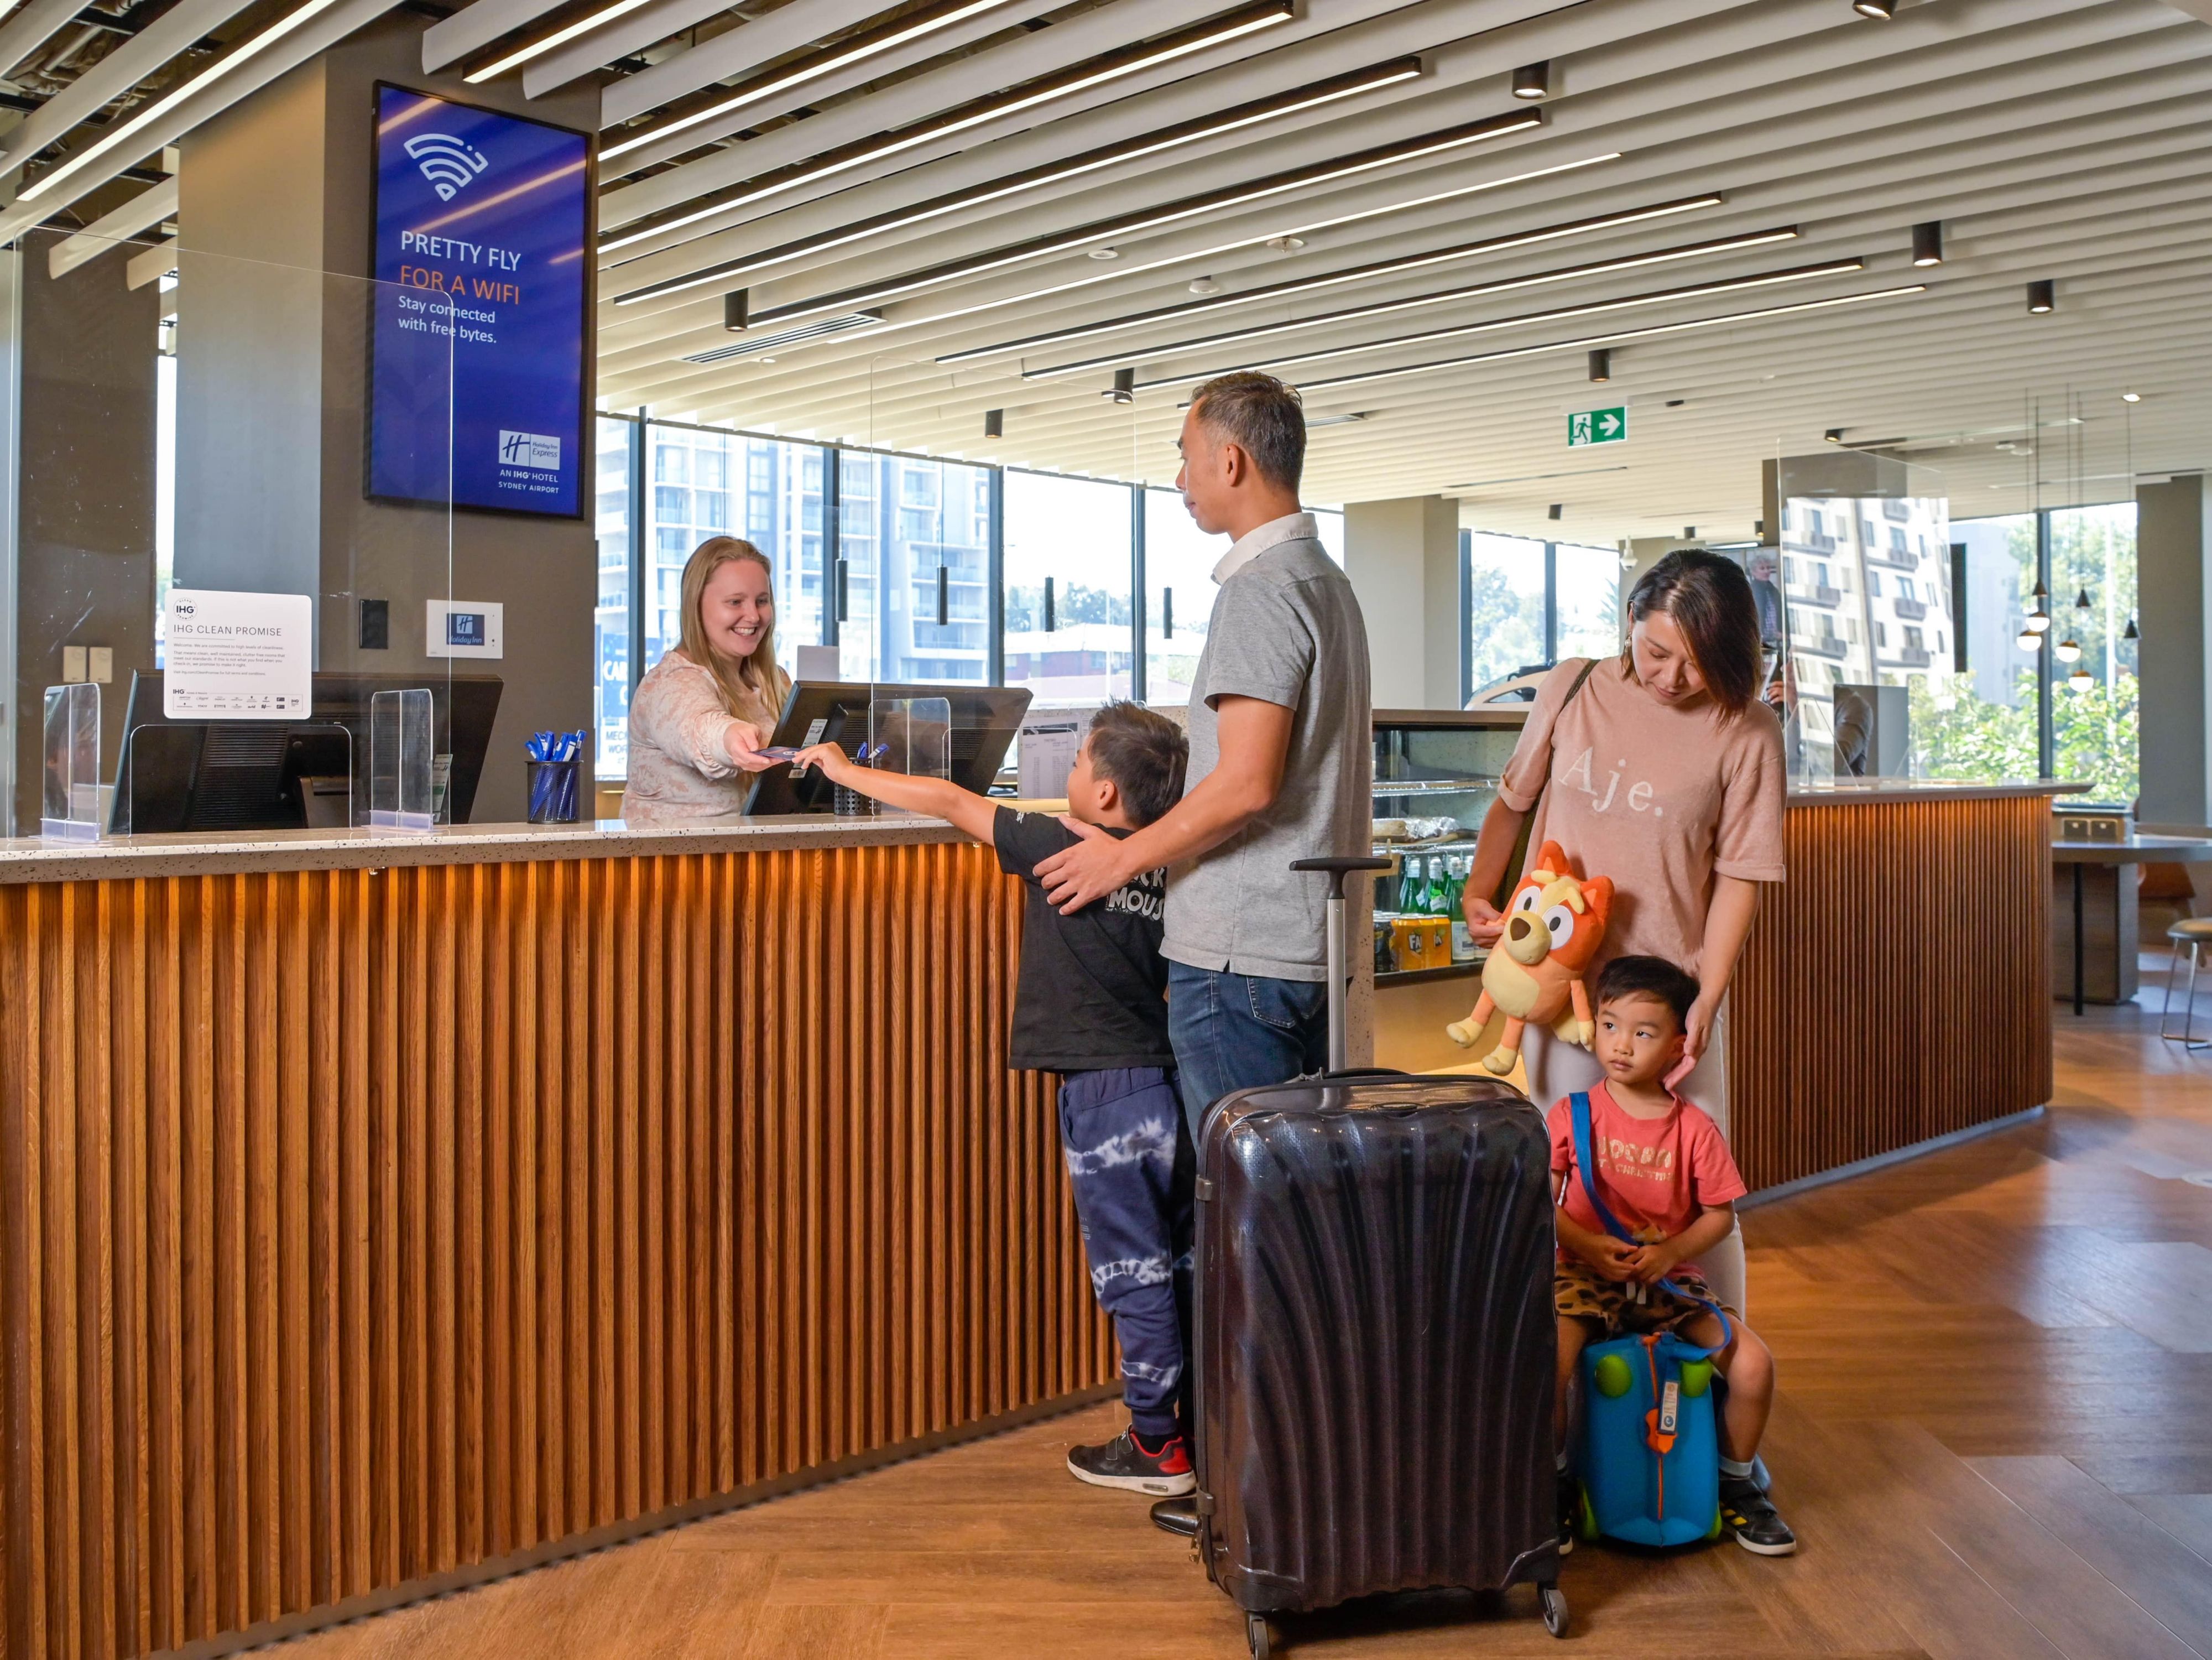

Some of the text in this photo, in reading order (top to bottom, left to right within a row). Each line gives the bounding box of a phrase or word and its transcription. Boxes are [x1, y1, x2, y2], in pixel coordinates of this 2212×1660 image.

[401, 230, 521, 271] PRETTY FLY
[400, 265, 519, 305] FOR A WIFI
[399, 295, 495, 324] Stay connected
[398, 318, 497, 344] with free bytes.
[532, 448, 558, 457] Express
[499, 481, 559, 493] SYDNEY AIRPORT
[532, 473, 558, 482] HOTEL
[176, 605, 194, 613] IHG
[174, 625, 281, 636] IHG CLEAN PROMISE
[1558, 746, 1663, 817] Aje.
[1108, 887, 1165, 920] MOUS
